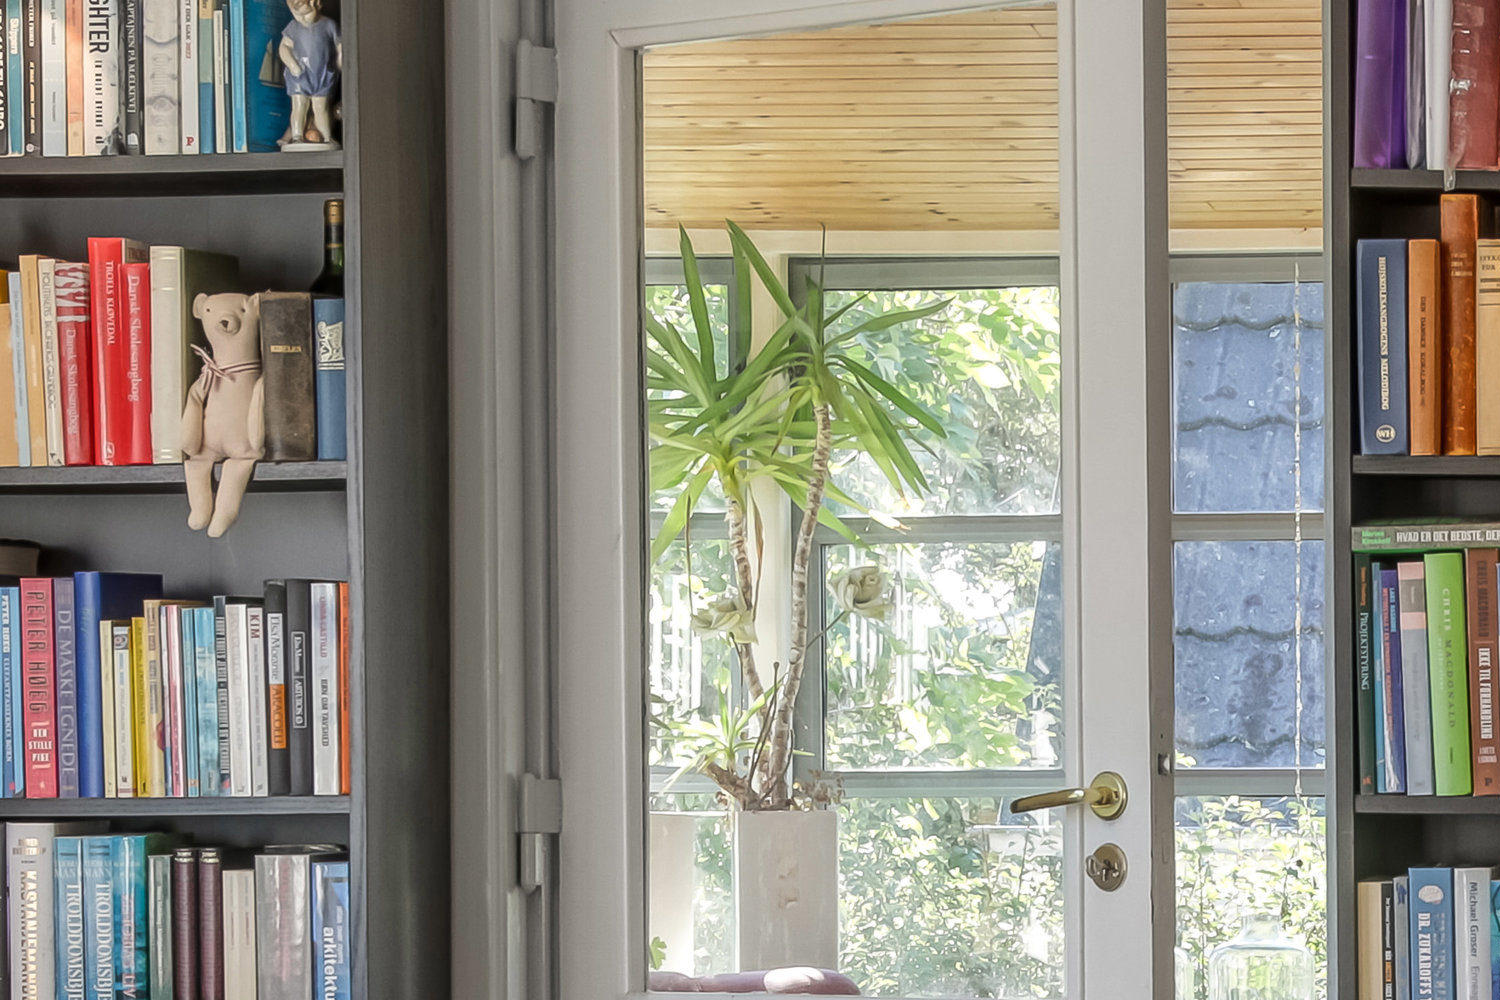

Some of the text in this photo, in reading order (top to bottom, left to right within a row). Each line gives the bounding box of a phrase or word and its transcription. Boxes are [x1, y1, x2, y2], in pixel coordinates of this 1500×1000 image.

[106, 260, 115, 346] TROELS KLØVEDAL
[127, 275, 142, 402] Dansk Skolesangbog
[1396, 530, 1419, 542] HVAD
[1421, 531, 1432, 542] ER
[1433, 531, 1449, 542] DET
[26, 591, 48, 713] PETER HØEG
[250, 614, 260, 639] KIM
[1359, 612, 1369, 690] PROJEKTSTYRING
[1442, 588, 1456, 728] CHRIS MACDONALD
[57, 610, 75, 775] DE MÅSKE EGNEDE
[1469, 882, 1479, 922] Michael
[1469, 925, 1479, 958] Groser
